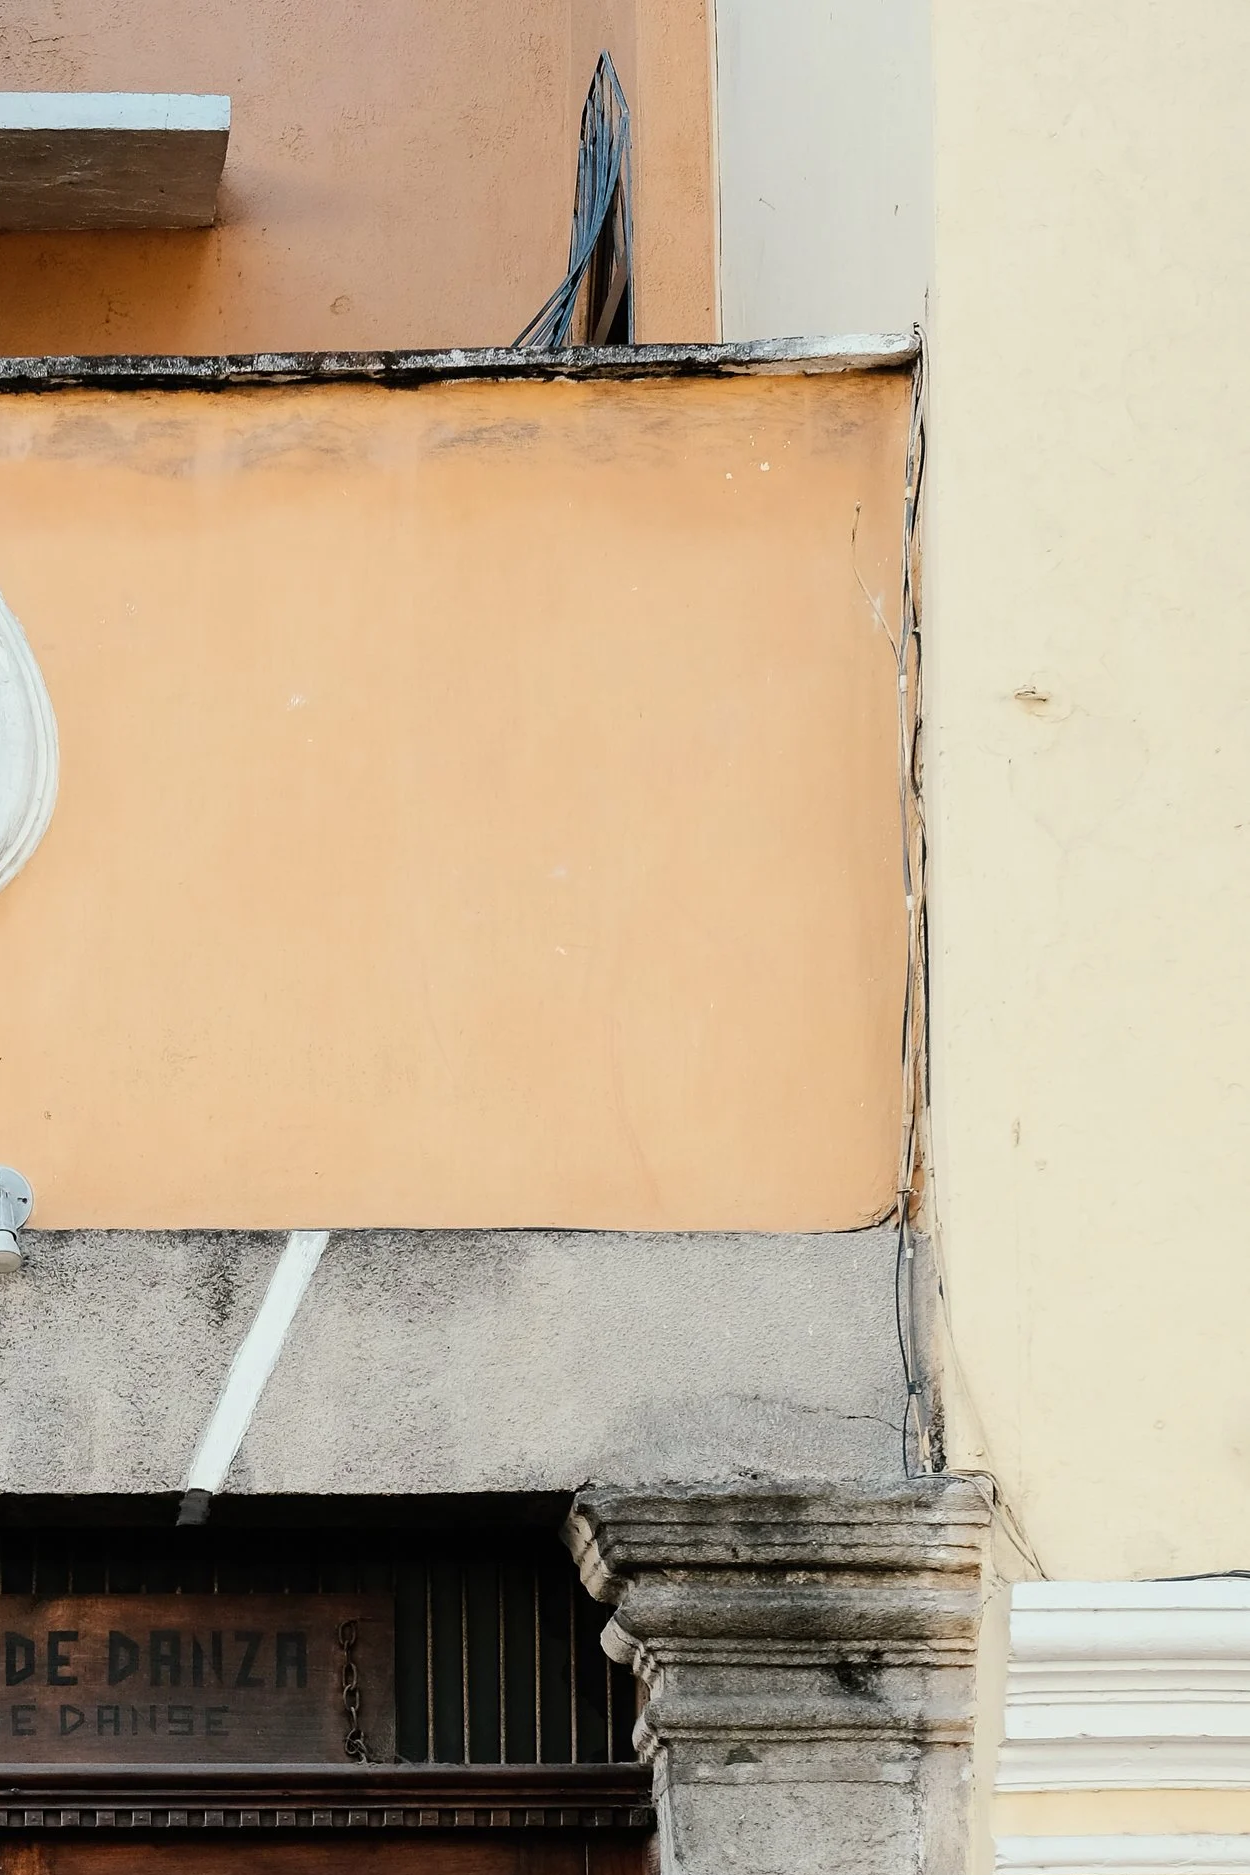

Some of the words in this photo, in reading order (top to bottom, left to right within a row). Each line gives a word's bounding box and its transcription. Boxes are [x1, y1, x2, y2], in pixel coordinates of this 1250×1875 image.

[4, 1631, 79, 1687] DE
[108, 1630, 308, 1689] DANZA
[60, 1704, 231, 1737] DANSE
